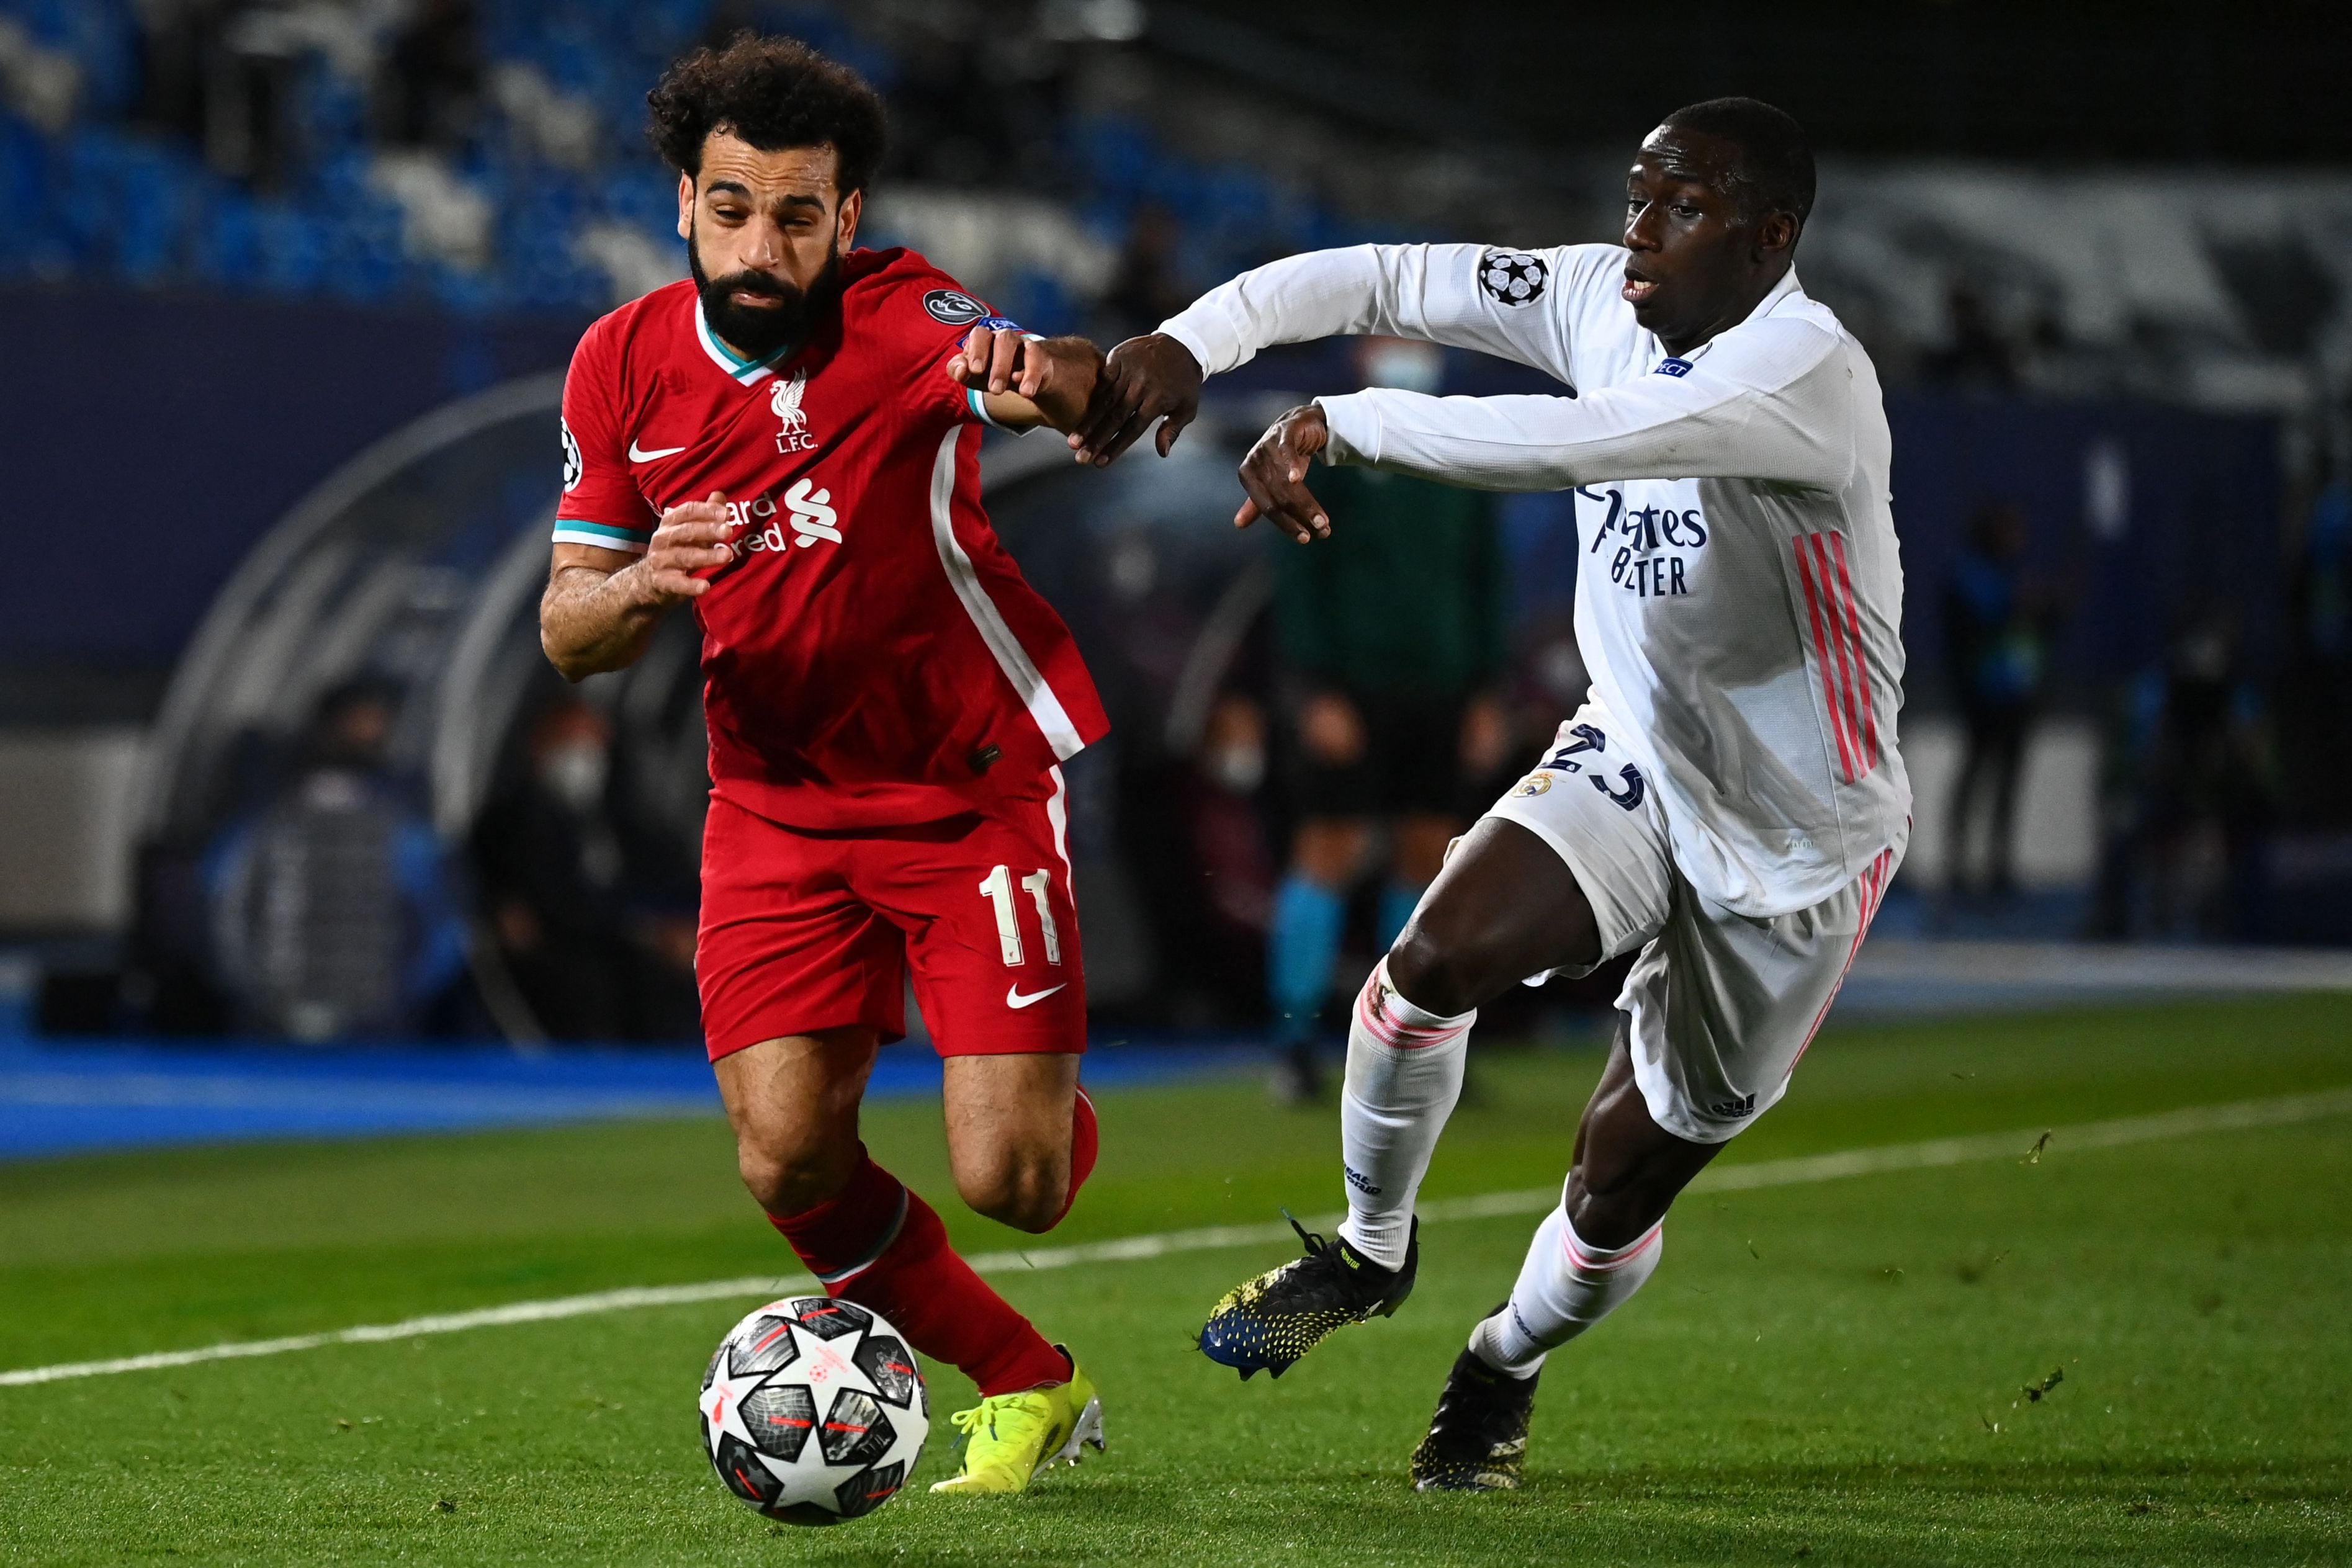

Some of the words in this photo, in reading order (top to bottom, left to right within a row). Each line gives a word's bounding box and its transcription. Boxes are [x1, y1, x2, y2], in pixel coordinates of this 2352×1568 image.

[776, 434, 819, 454] L.F.C.
[725, 491, 777, 526] ard
[978, 864, 1061, 967] 11
